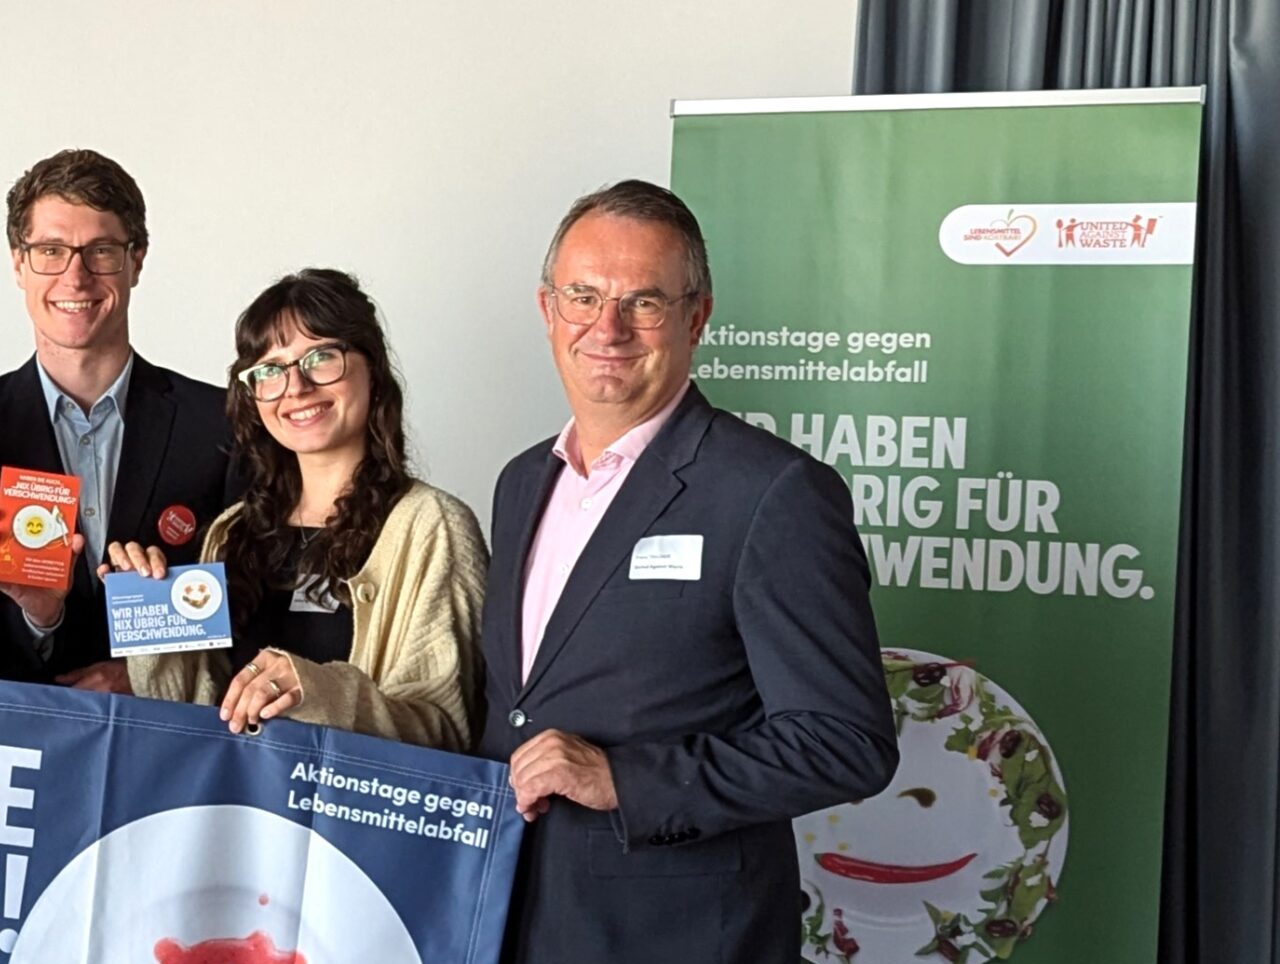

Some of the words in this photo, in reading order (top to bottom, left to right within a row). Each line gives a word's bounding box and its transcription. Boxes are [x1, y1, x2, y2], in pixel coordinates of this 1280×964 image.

[1080, 221, 1128, 231] UNITED
[1080, 230, 1126, 238] AGAINST
[1080, 238, 1127, 248] WASTE
[847, 329, 931, 353] gegen
[790, 411, 968, 470] HABEN
[851, 474, 944, 529] RIG
[955, 471, 1061, 534] FÜR
[859, 532, 1156, 600] WENDUNG.
[111, 607, 132, 620] WIR
[134, 603, 169, 618] HABEN
[113, 619, 133, 632] NIX
[113, 623, 207, 643] VERSCHWENDUNG.
[290, 762, 421, 806] Aktionstage
[424, 793, 494, 820] gegen
[287, 790, 489, 849] Lebensmittelabfall
